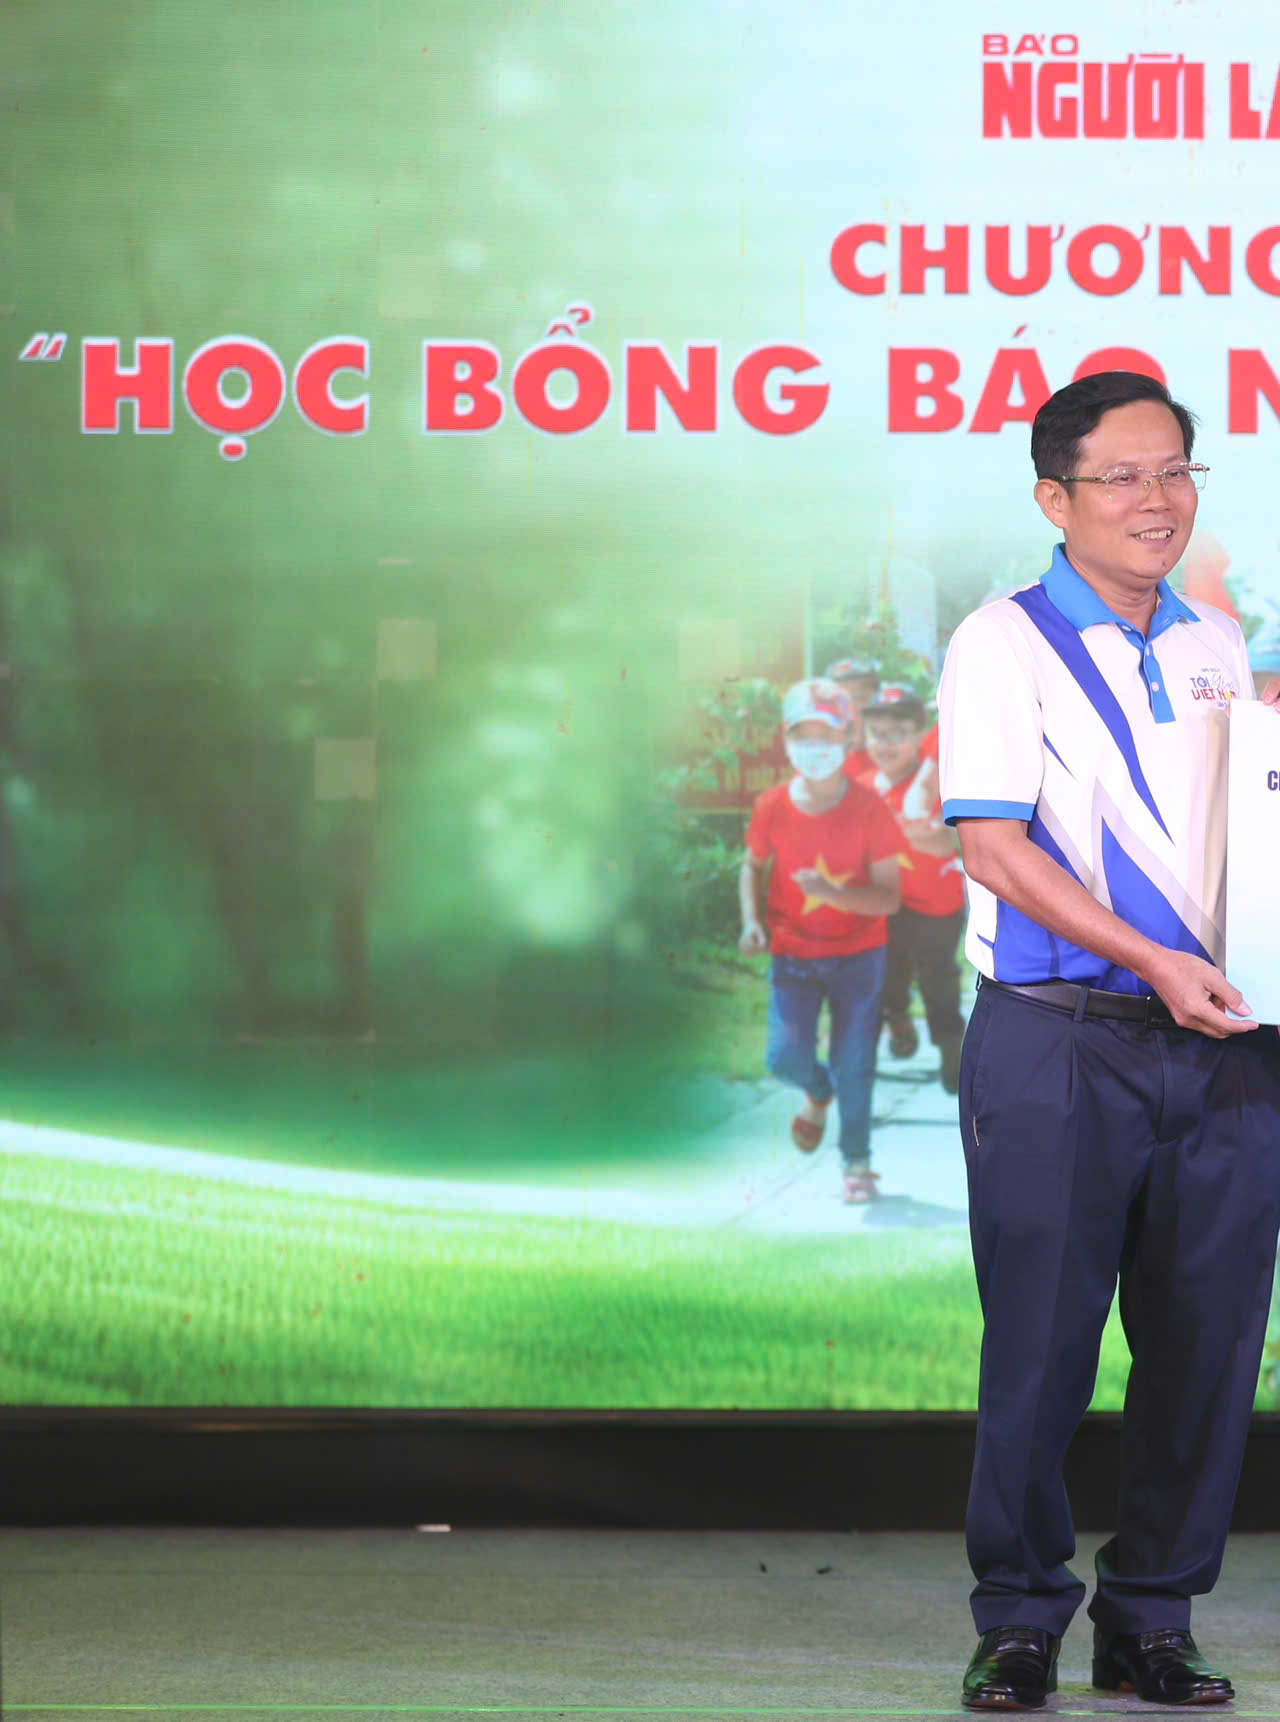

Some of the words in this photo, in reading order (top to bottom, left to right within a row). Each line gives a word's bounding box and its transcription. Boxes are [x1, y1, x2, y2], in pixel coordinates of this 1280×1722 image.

[982, 33, 1079, 56] BÁO
[982, 53, 1205, 139] NGƯỜI
[422, 302, 832, 437] BỔNG
